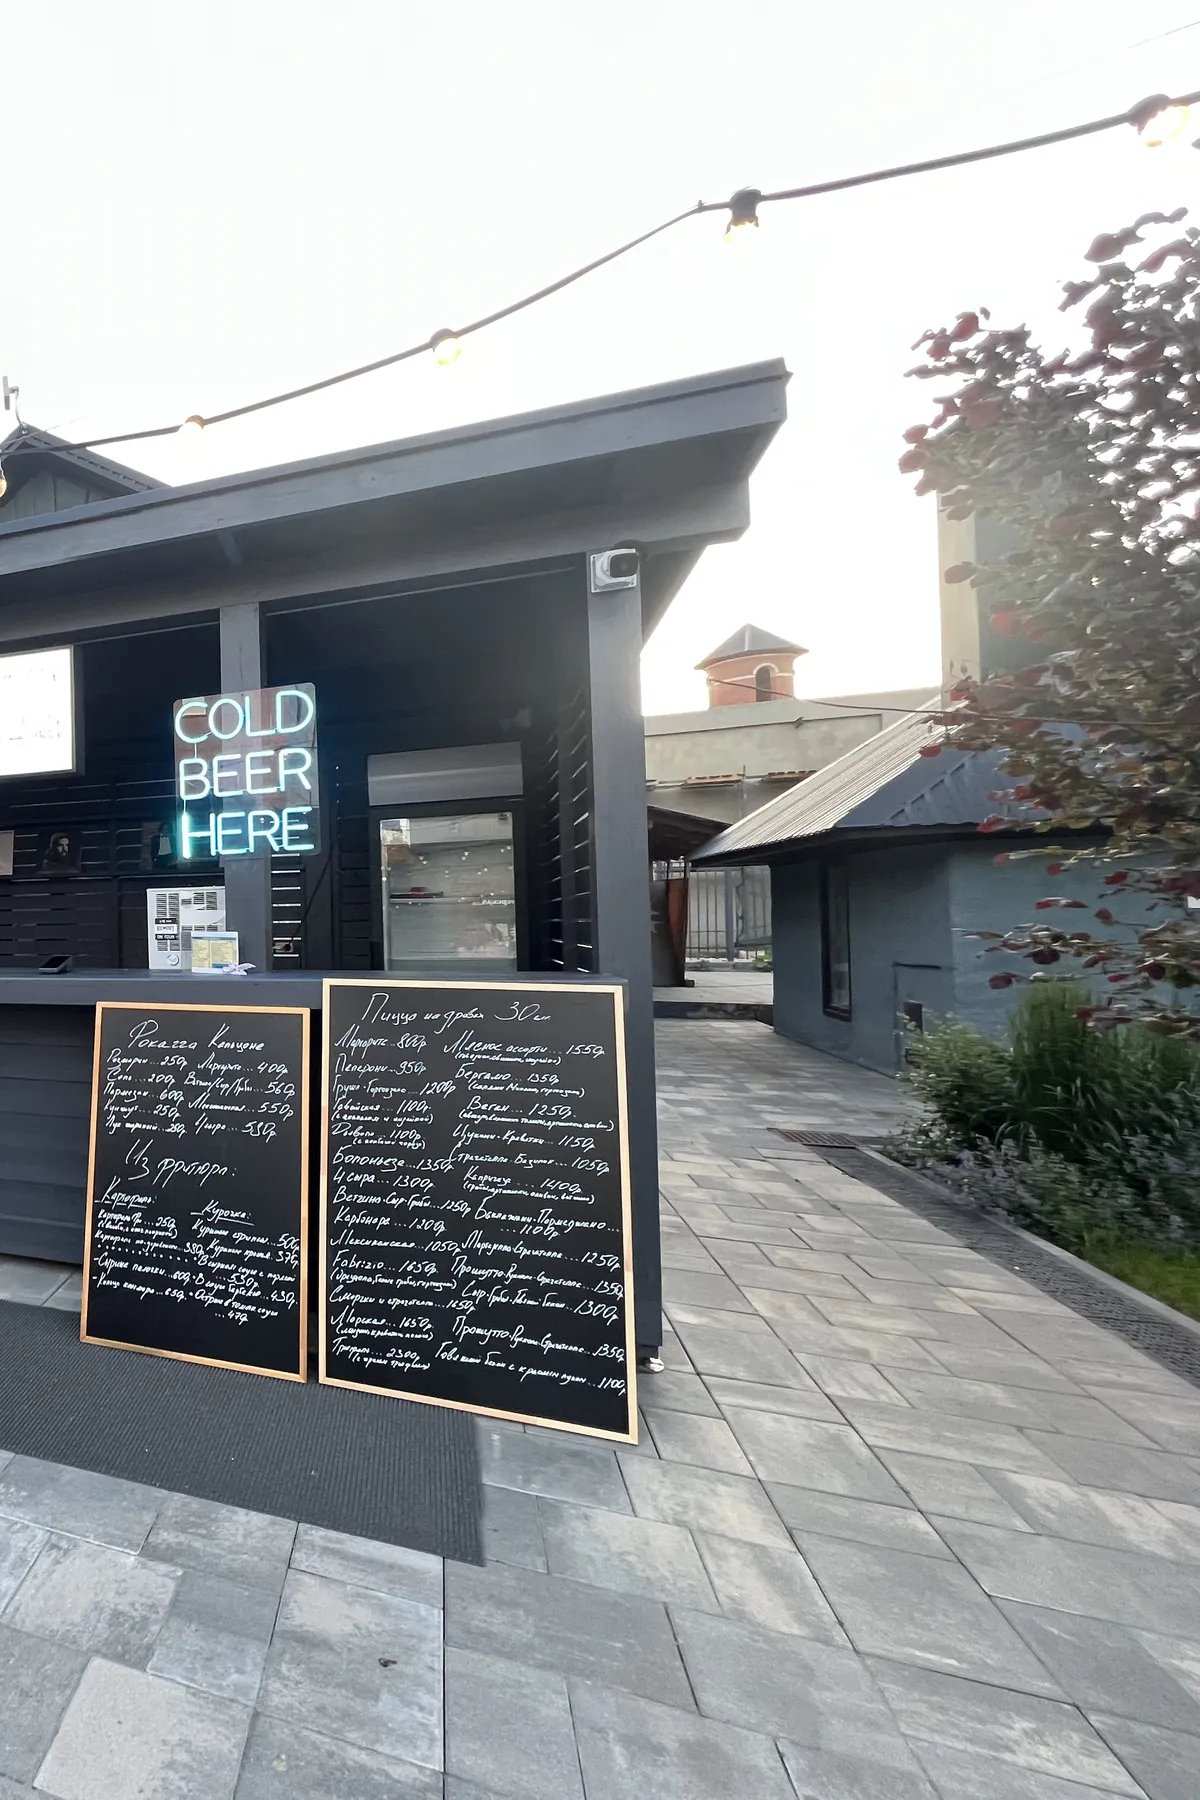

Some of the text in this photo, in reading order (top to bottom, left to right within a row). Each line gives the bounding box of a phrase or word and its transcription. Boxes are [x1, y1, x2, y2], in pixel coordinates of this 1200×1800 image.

[175, 690, 314, 744] COLD
[179, 747, 311, 800] BEER
[181, 807, 314, 859] HERE
